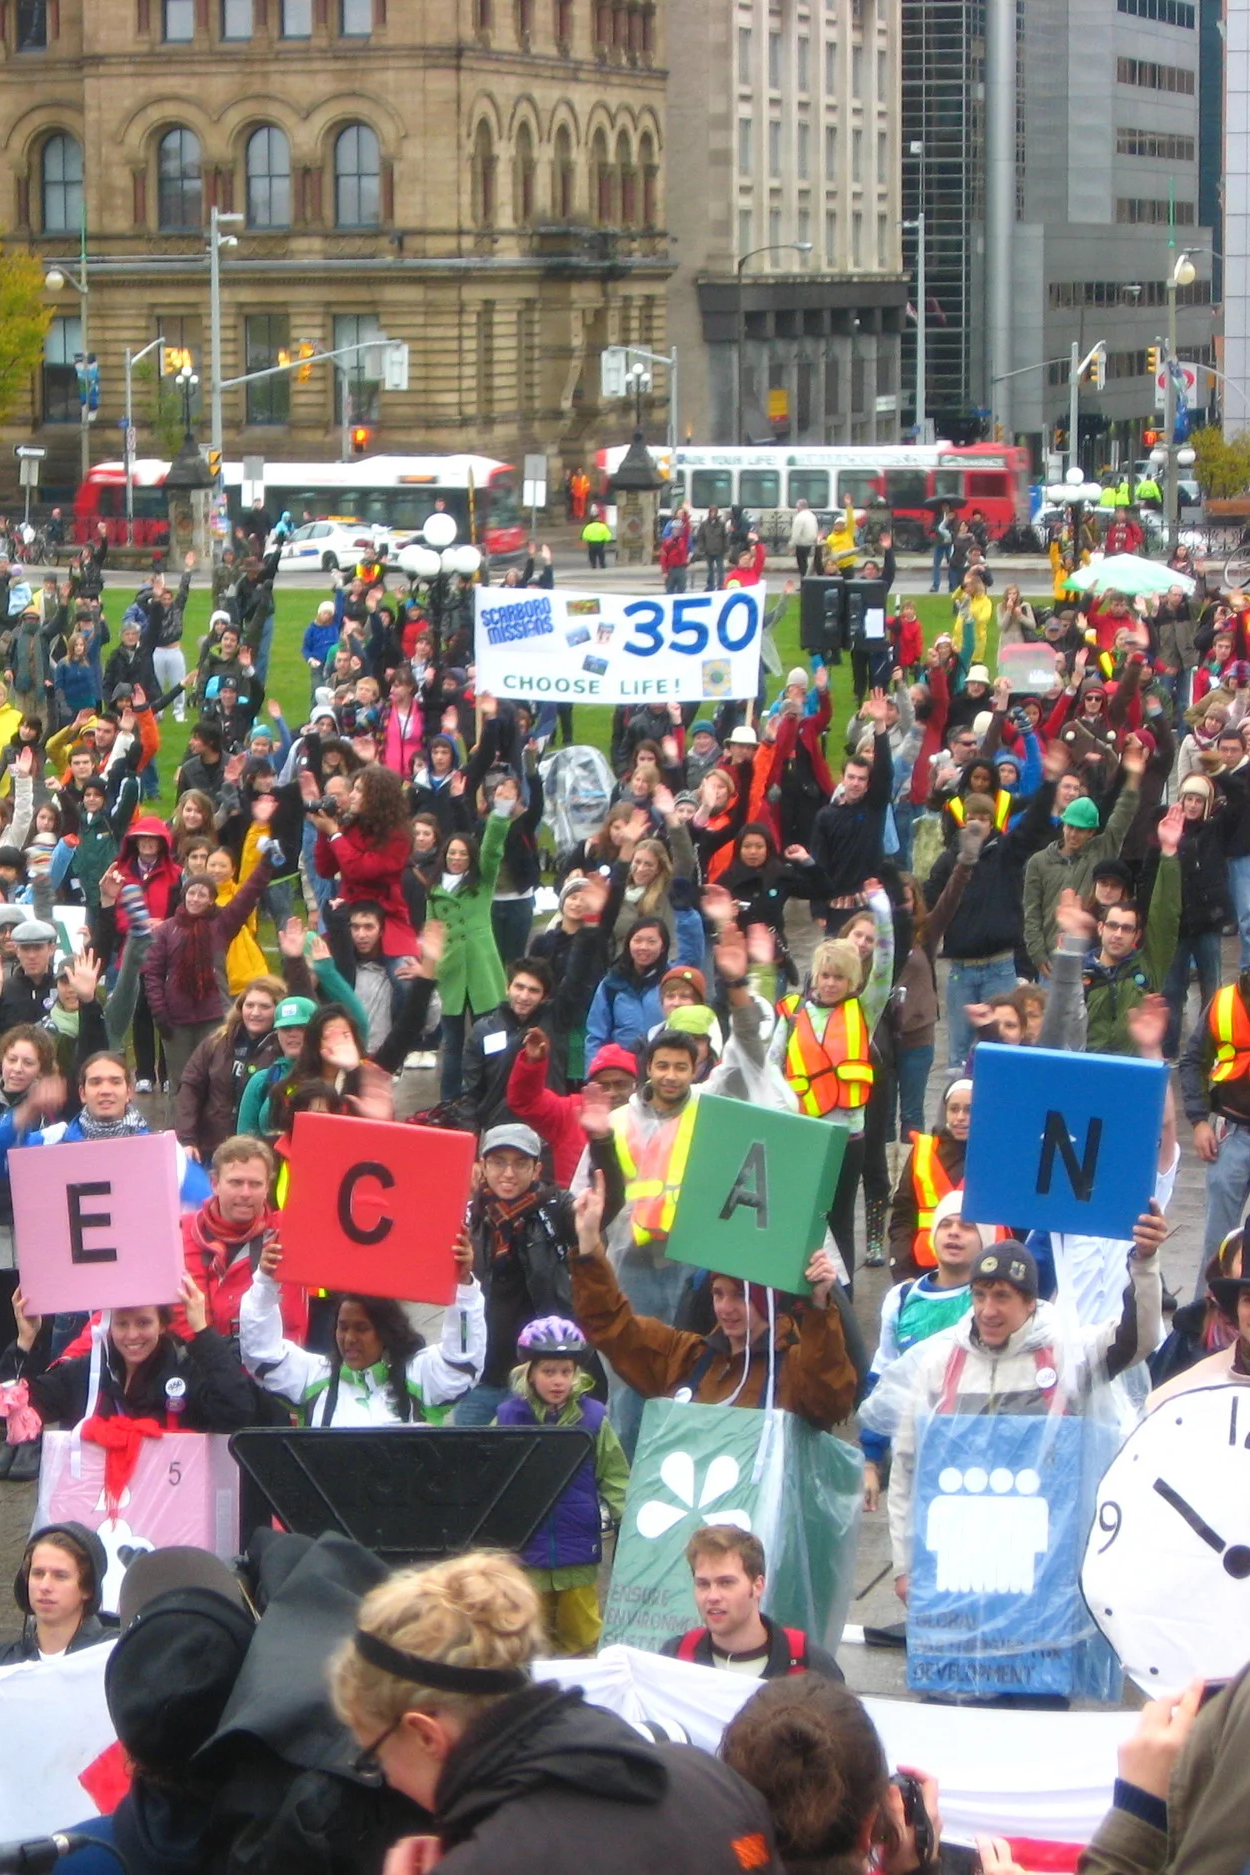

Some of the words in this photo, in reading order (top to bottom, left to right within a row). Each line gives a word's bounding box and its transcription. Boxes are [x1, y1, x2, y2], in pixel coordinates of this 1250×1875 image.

[480, 597, 552, 627] SCARBORO
[486, 614, 554, 645] MISSIONS
[622, 592, 759, 656] 350
[503, 674, 600, 694] CHOOSE
[620, 678, 680, 695] LIFE!
[1036, 1110, 1102, 1202] N
[337, 1160, 396, 1246] C
[718, 1141, 769, 1229] A
[66, 1181, 118, 1265] E
[1229, 1396, 1250, 1450] 1
[168, 1461, 182, 1486] 5
[1097, 1500, 1123, 1556] 9
[913, 1661, 1036, 1685] DEVELOPMENT
